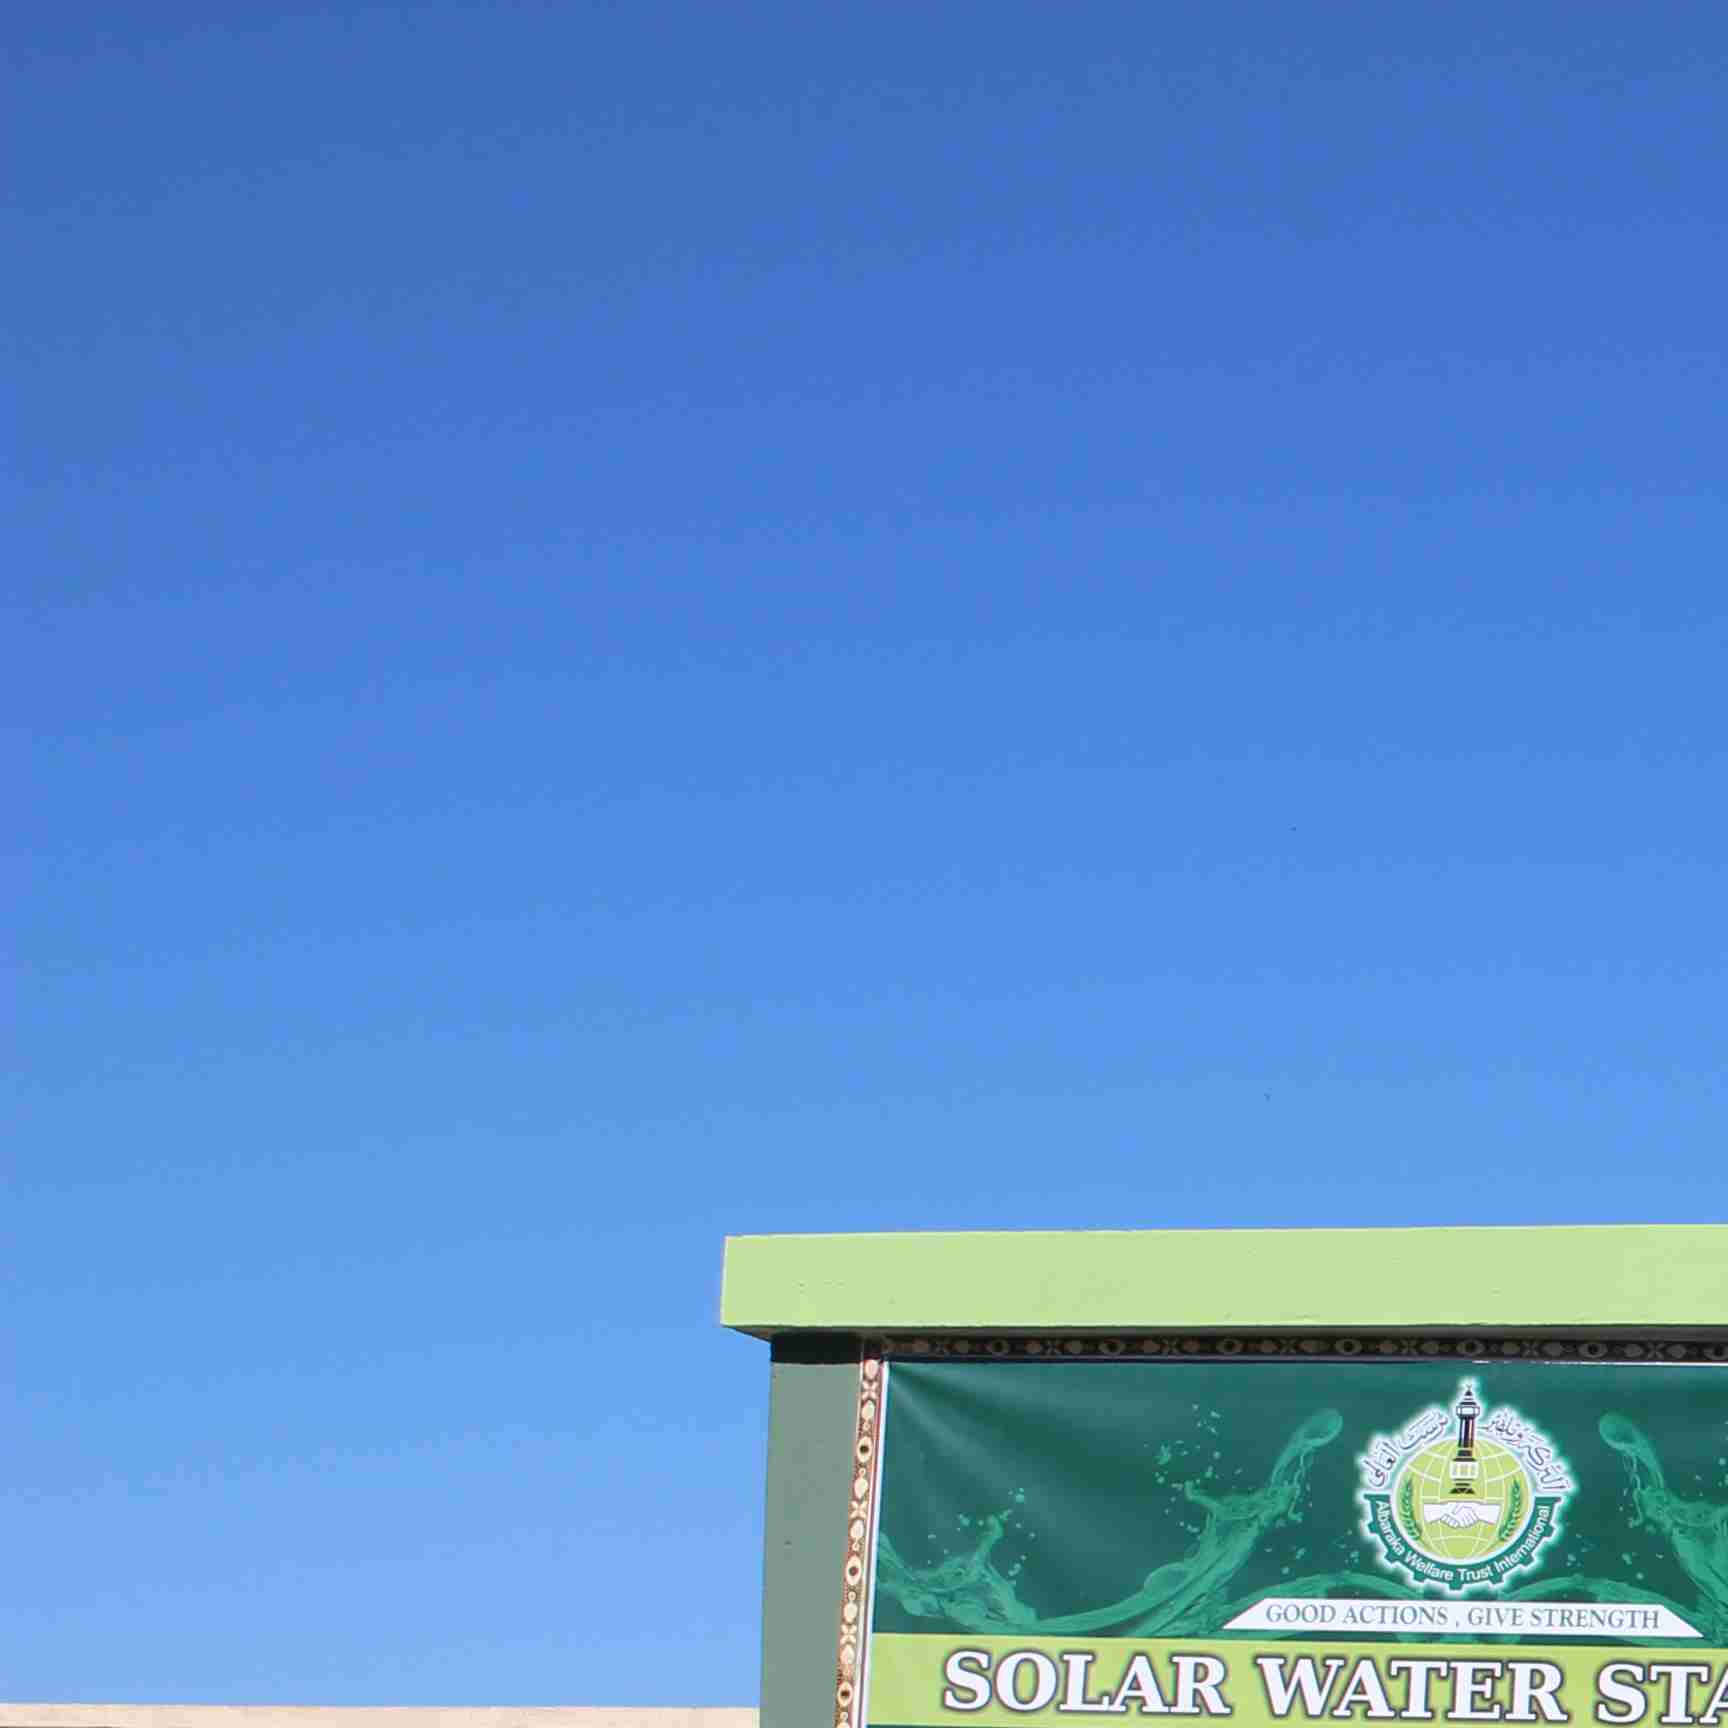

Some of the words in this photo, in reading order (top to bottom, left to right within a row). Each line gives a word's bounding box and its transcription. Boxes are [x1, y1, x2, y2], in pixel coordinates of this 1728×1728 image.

[1375, 1501, 1406, 1556] Albaraka
[1404, 1551, 1454, 1582] Welfare
[1458, 1566, 1495, 1582] Trust
[1494, 1504, 1552, 1573] International
[1265, 1603, 1337, 1624] GOOD
[1342, 1604, 1448, 1625] ACTIONS
[1467, 1606, 1524, 1626] GIVE
[1529, 1608, 1660, 1629] STRENGTH
[943, 1650, 1231, 1716] SOLAR
[1256, 1655, 1568, 1722] WATER
